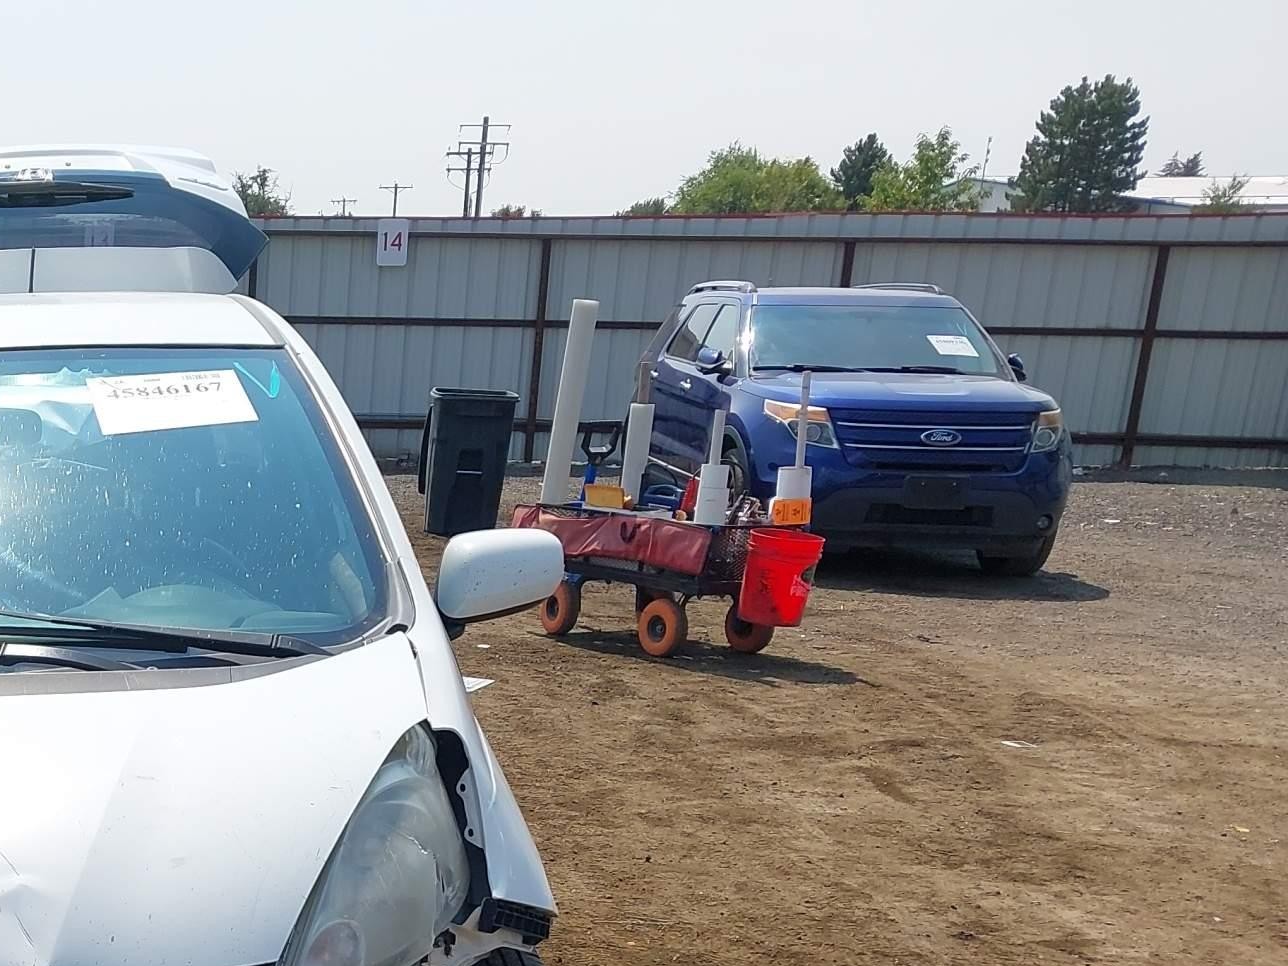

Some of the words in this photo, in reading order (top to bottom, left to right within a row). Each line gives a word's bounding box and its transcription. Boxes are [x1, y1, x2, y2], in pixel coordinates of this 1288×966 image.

[383, 231, 402, 251] 14
[107, 381, 221, 399] 45846167
[929, 431, 954, 442] Ford
